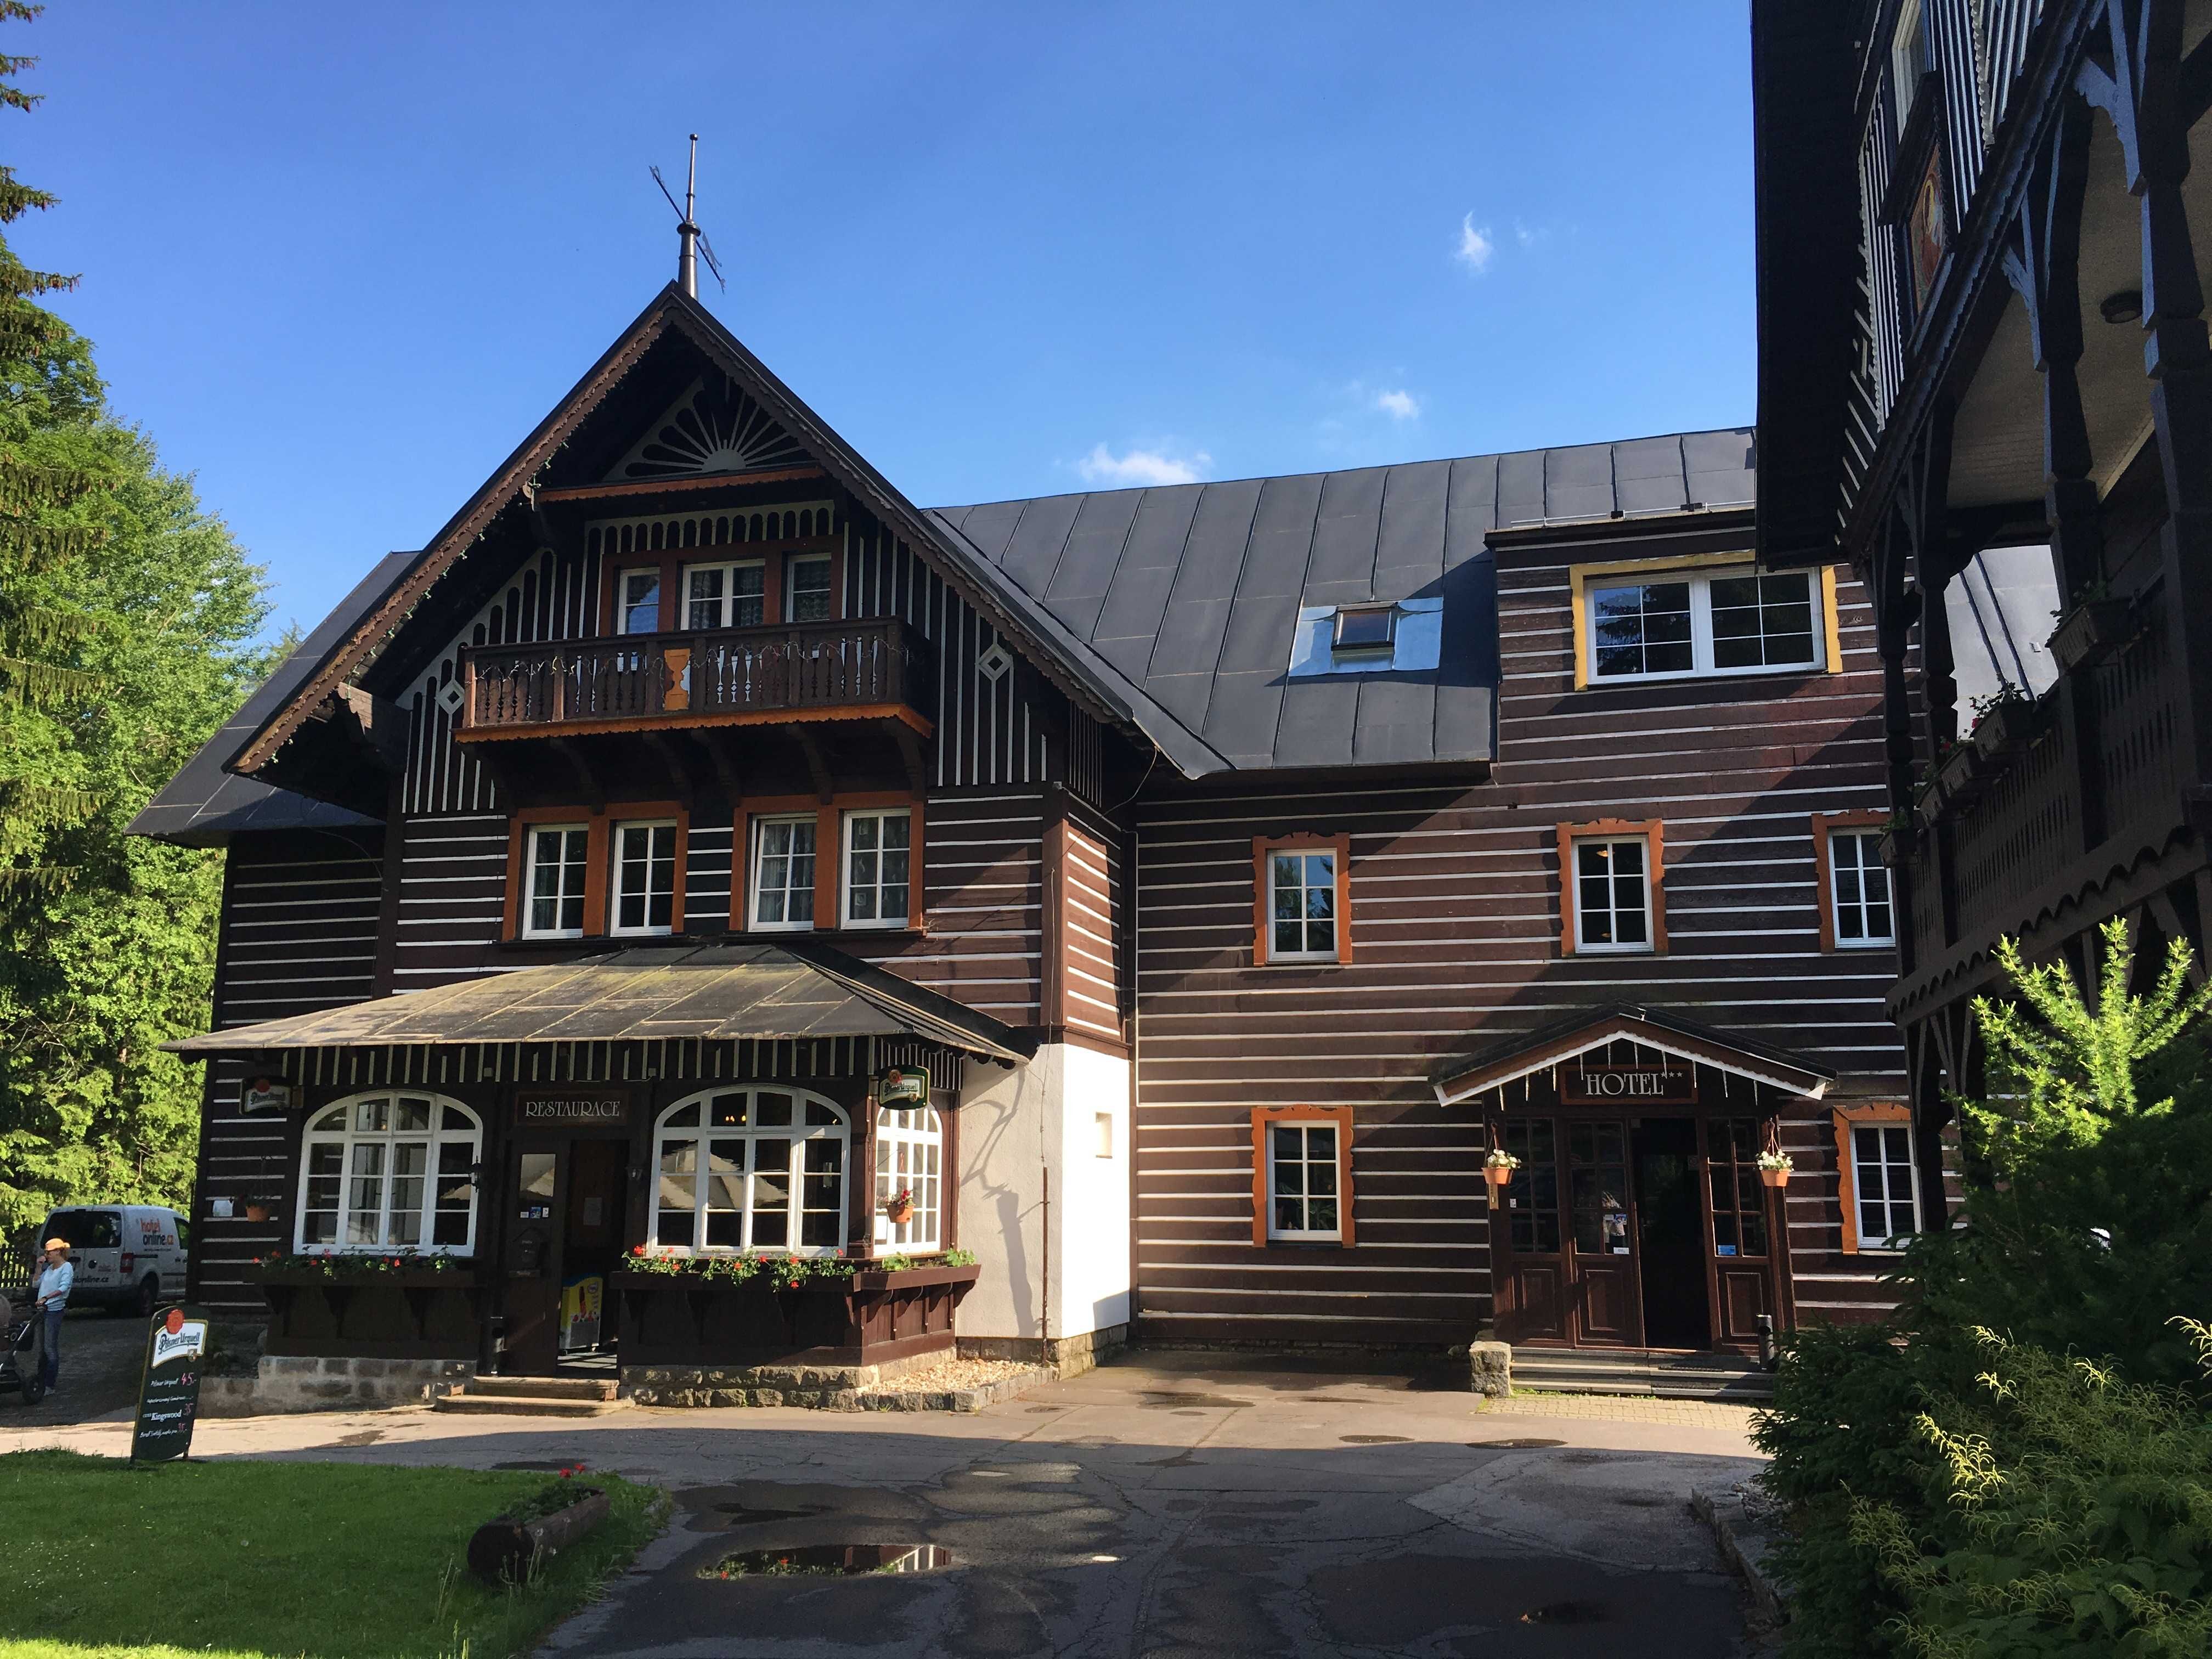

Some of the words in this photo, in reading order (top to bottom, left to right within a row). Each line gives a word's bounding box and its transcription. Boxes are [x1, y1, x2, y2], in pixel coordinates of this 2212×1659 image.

[1585, 1072, 1664, 1096] HOTEL
[525, 1101, 620, 1118] RESTAURACE
[158, 1333, 180, 1355] Pilsner
[180, 1332, 200, 1346] Urquell
[151, 1409, 182, 1422] Kingswood
